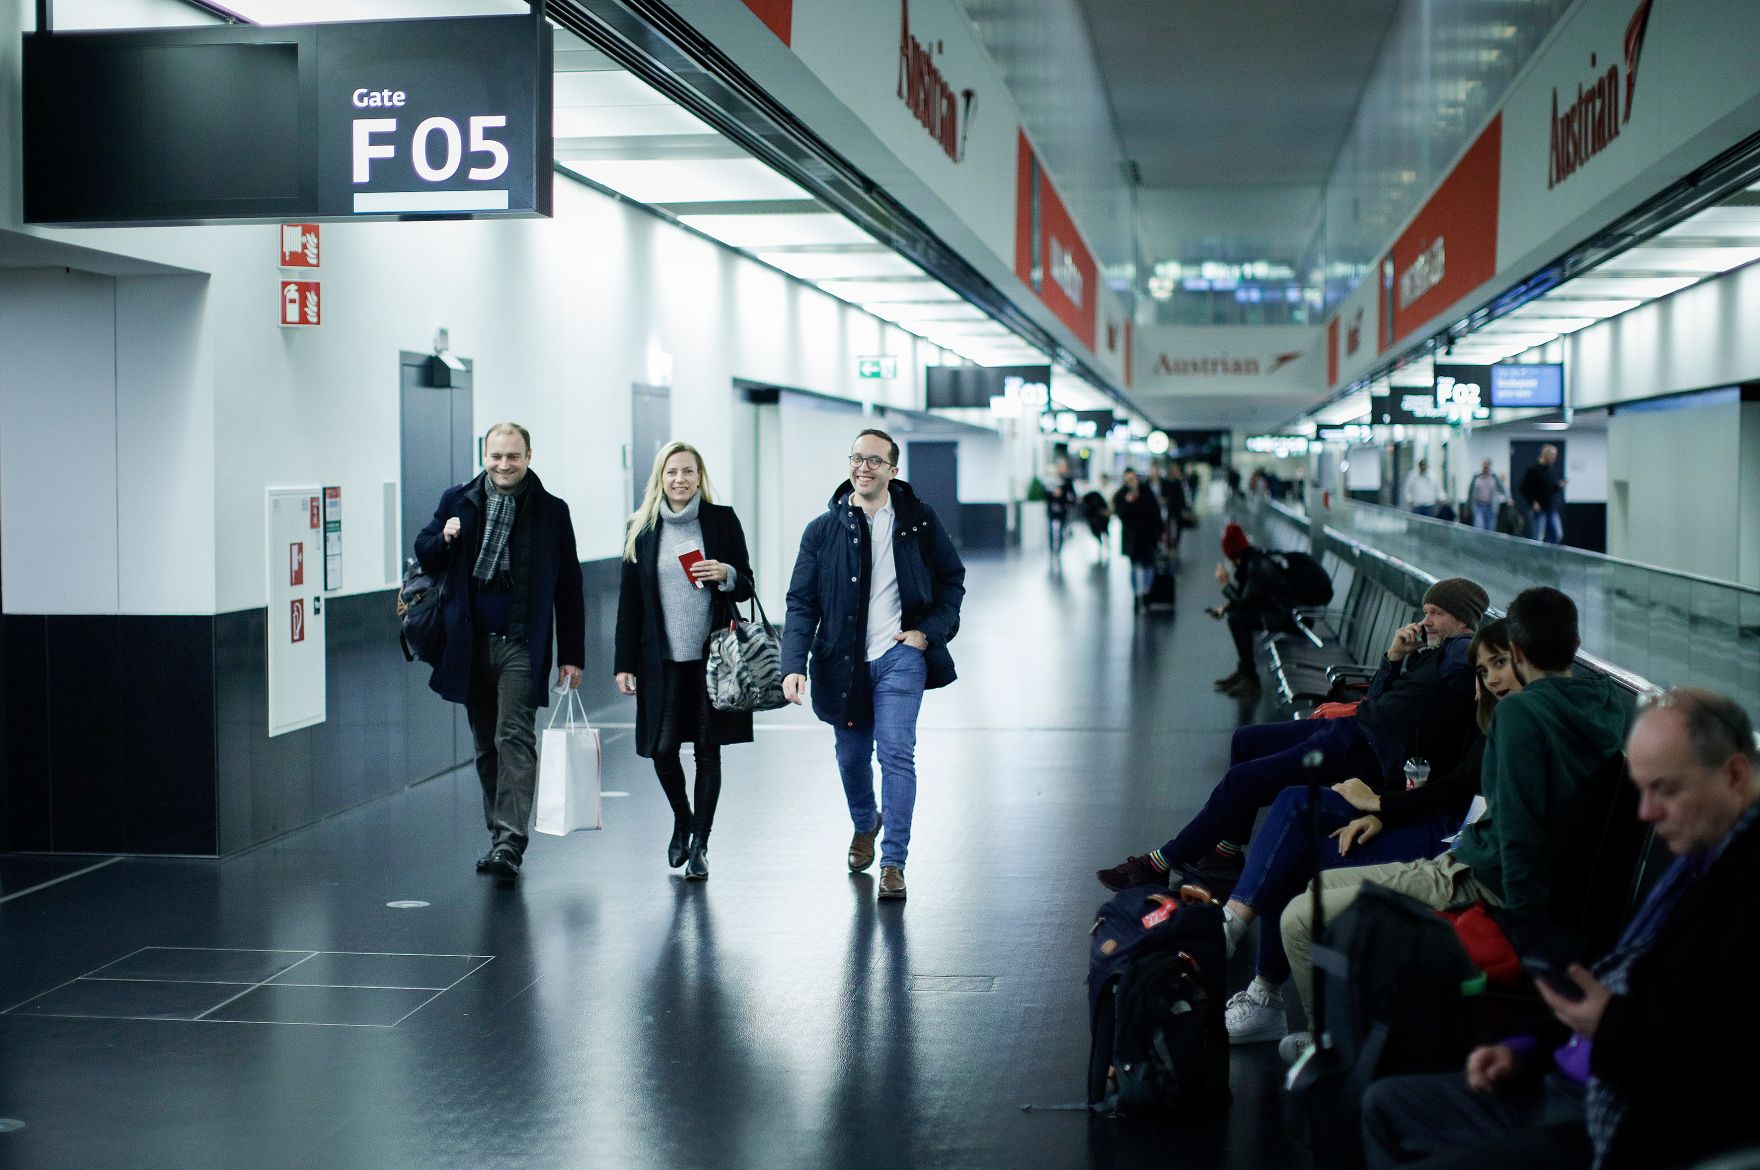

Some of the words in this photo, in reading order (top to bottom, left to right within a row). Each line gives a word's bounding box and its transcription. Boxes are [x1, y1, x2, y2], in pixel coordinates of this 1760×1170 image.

[352, 88, 407, 107] Gate
[897, 0, 959, 163] Austrian
[352, 118, 397, 184] F
[412, 115, 509, 182] 05
[1547, 51, 1621, 190] Austrian
[1153, 351, 1259, 376] Austrian
